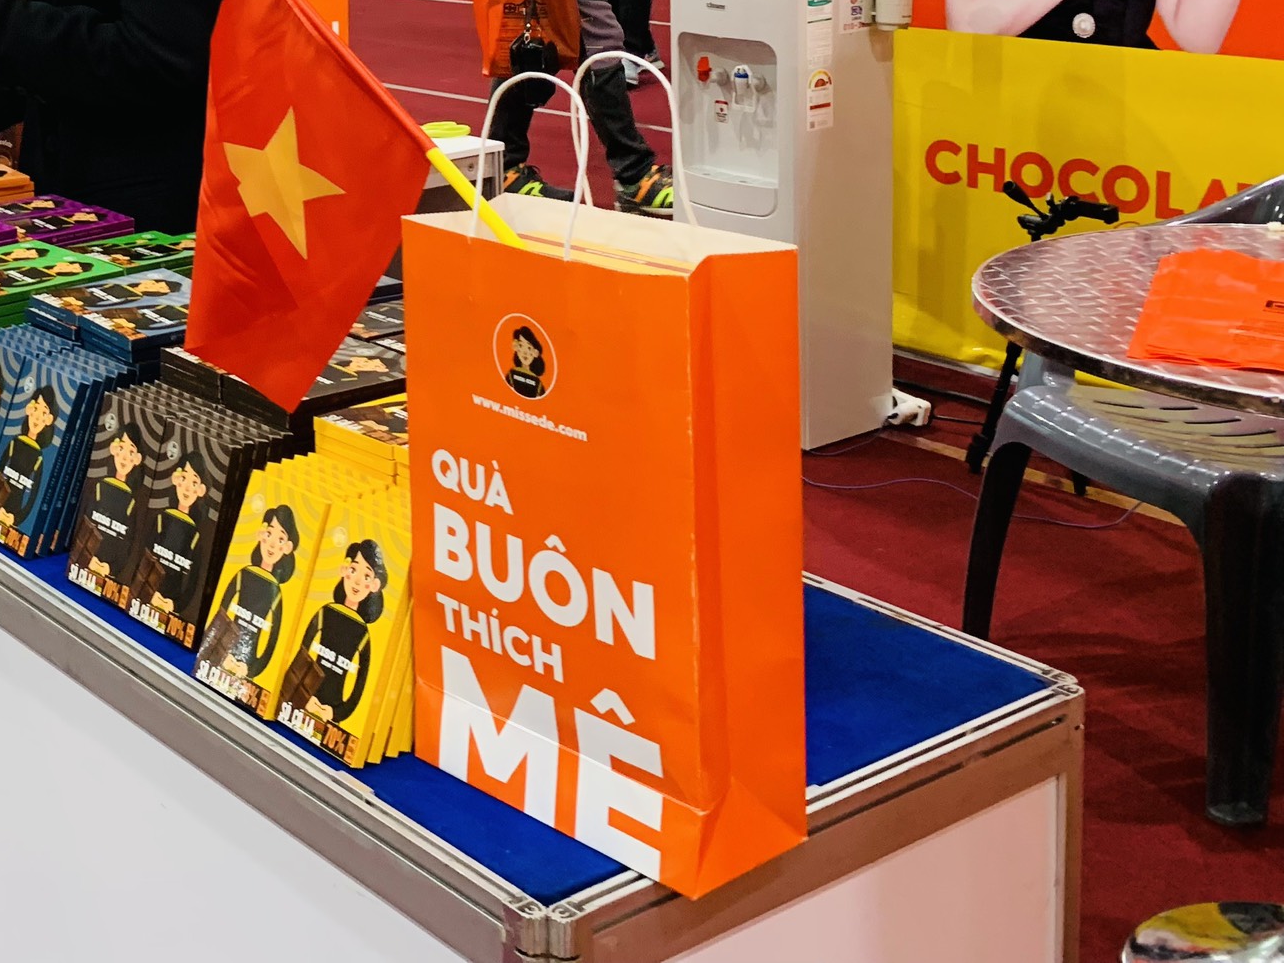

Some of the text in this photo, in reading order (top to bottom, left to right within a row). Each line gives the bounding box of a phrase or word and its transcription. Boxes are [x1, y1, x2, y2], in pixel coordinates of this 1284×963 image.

[472, 393, 588, 442] www.missede.com
[431, 448, 514, 515] QUÀ
[434, 502, 656, 660] BUÔN
[436, 591, 564, 684] THÍCH
[323, 723, 347, 755] 70%
[438, 645, 664, 883] MÊ
